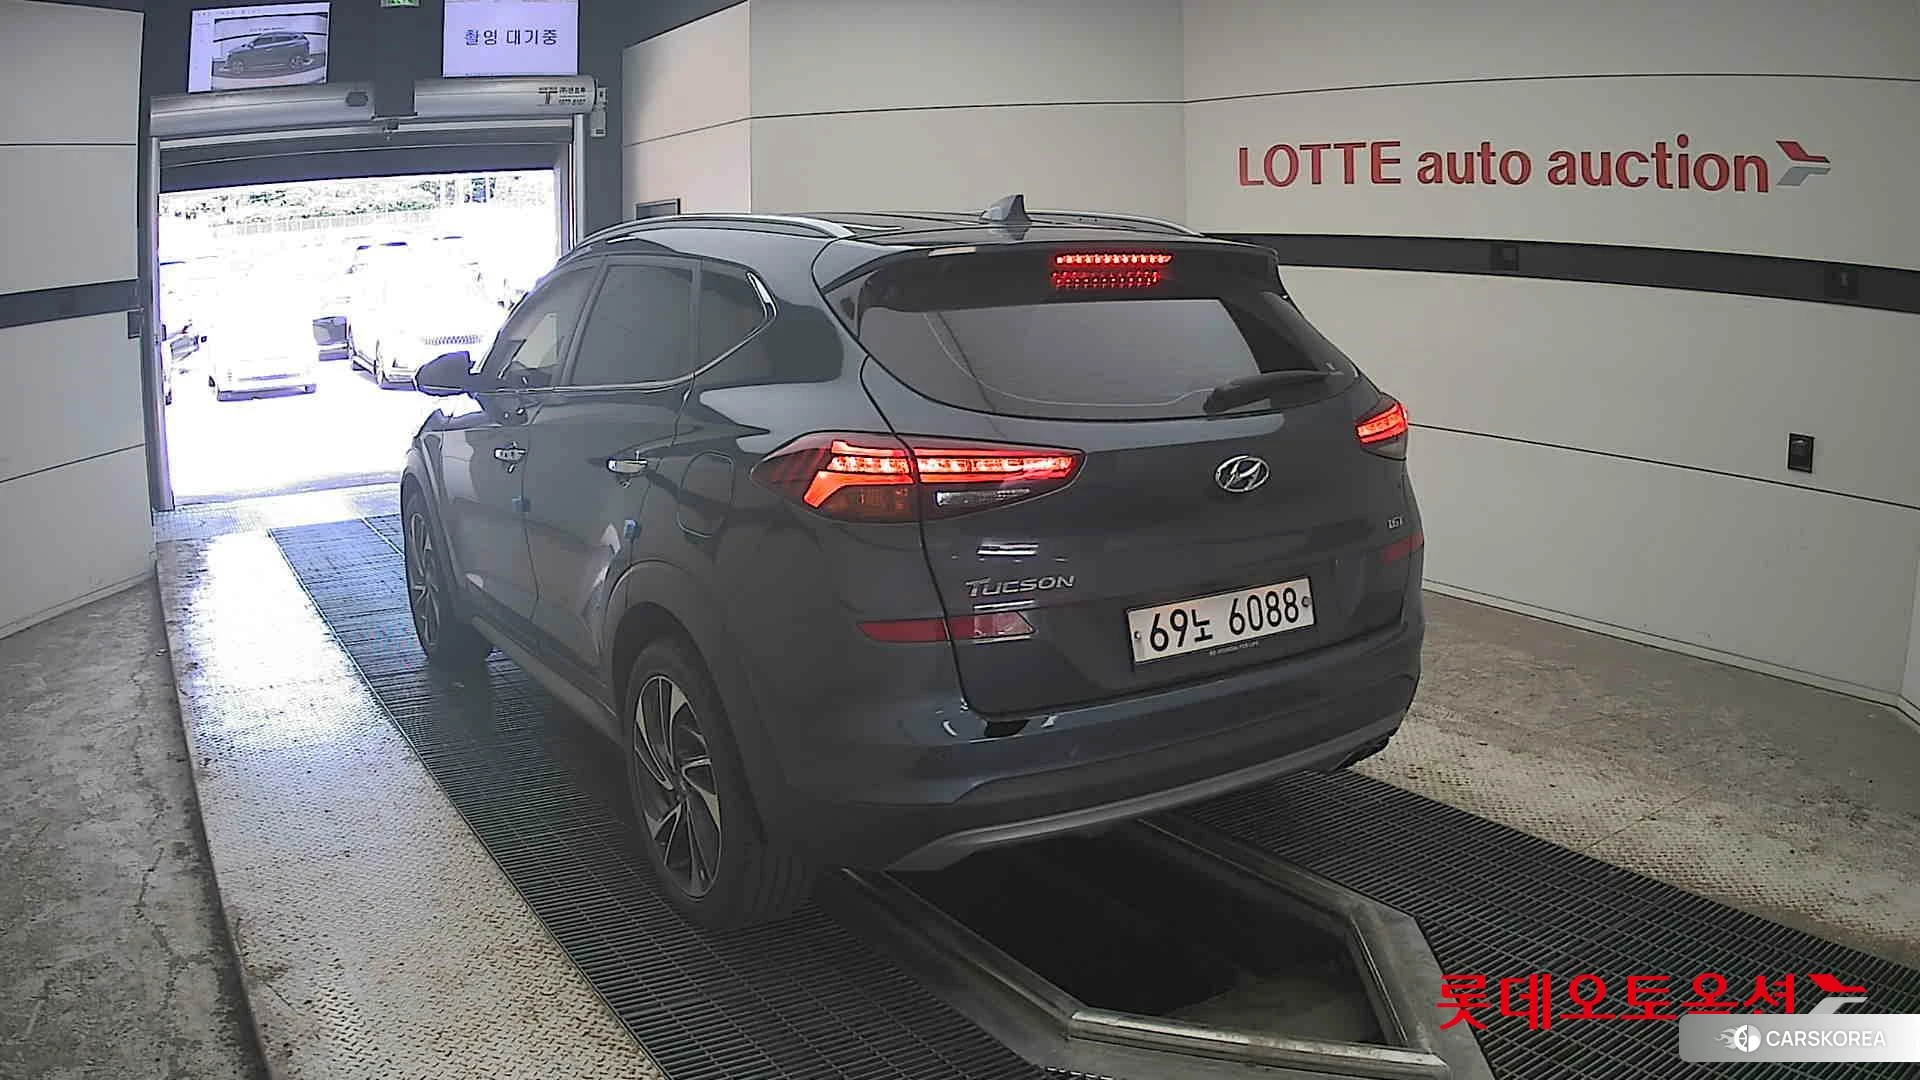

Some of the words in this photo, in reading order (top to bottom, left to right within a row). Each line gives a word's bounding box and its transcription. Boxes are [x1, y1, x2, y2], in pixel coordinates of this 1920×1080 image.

[505, 28, 558, 46] 대기중
[1239, 140, 1400, 188] LOTTE
[1418, 143, 1532, 185] auto
[1548, 135, 1770, 193] auction
[965, 575, 1075, 597] TUCSON
[1150, 608, 1214, 652] 69노
[1228, 587, 1299, 636] 6088
